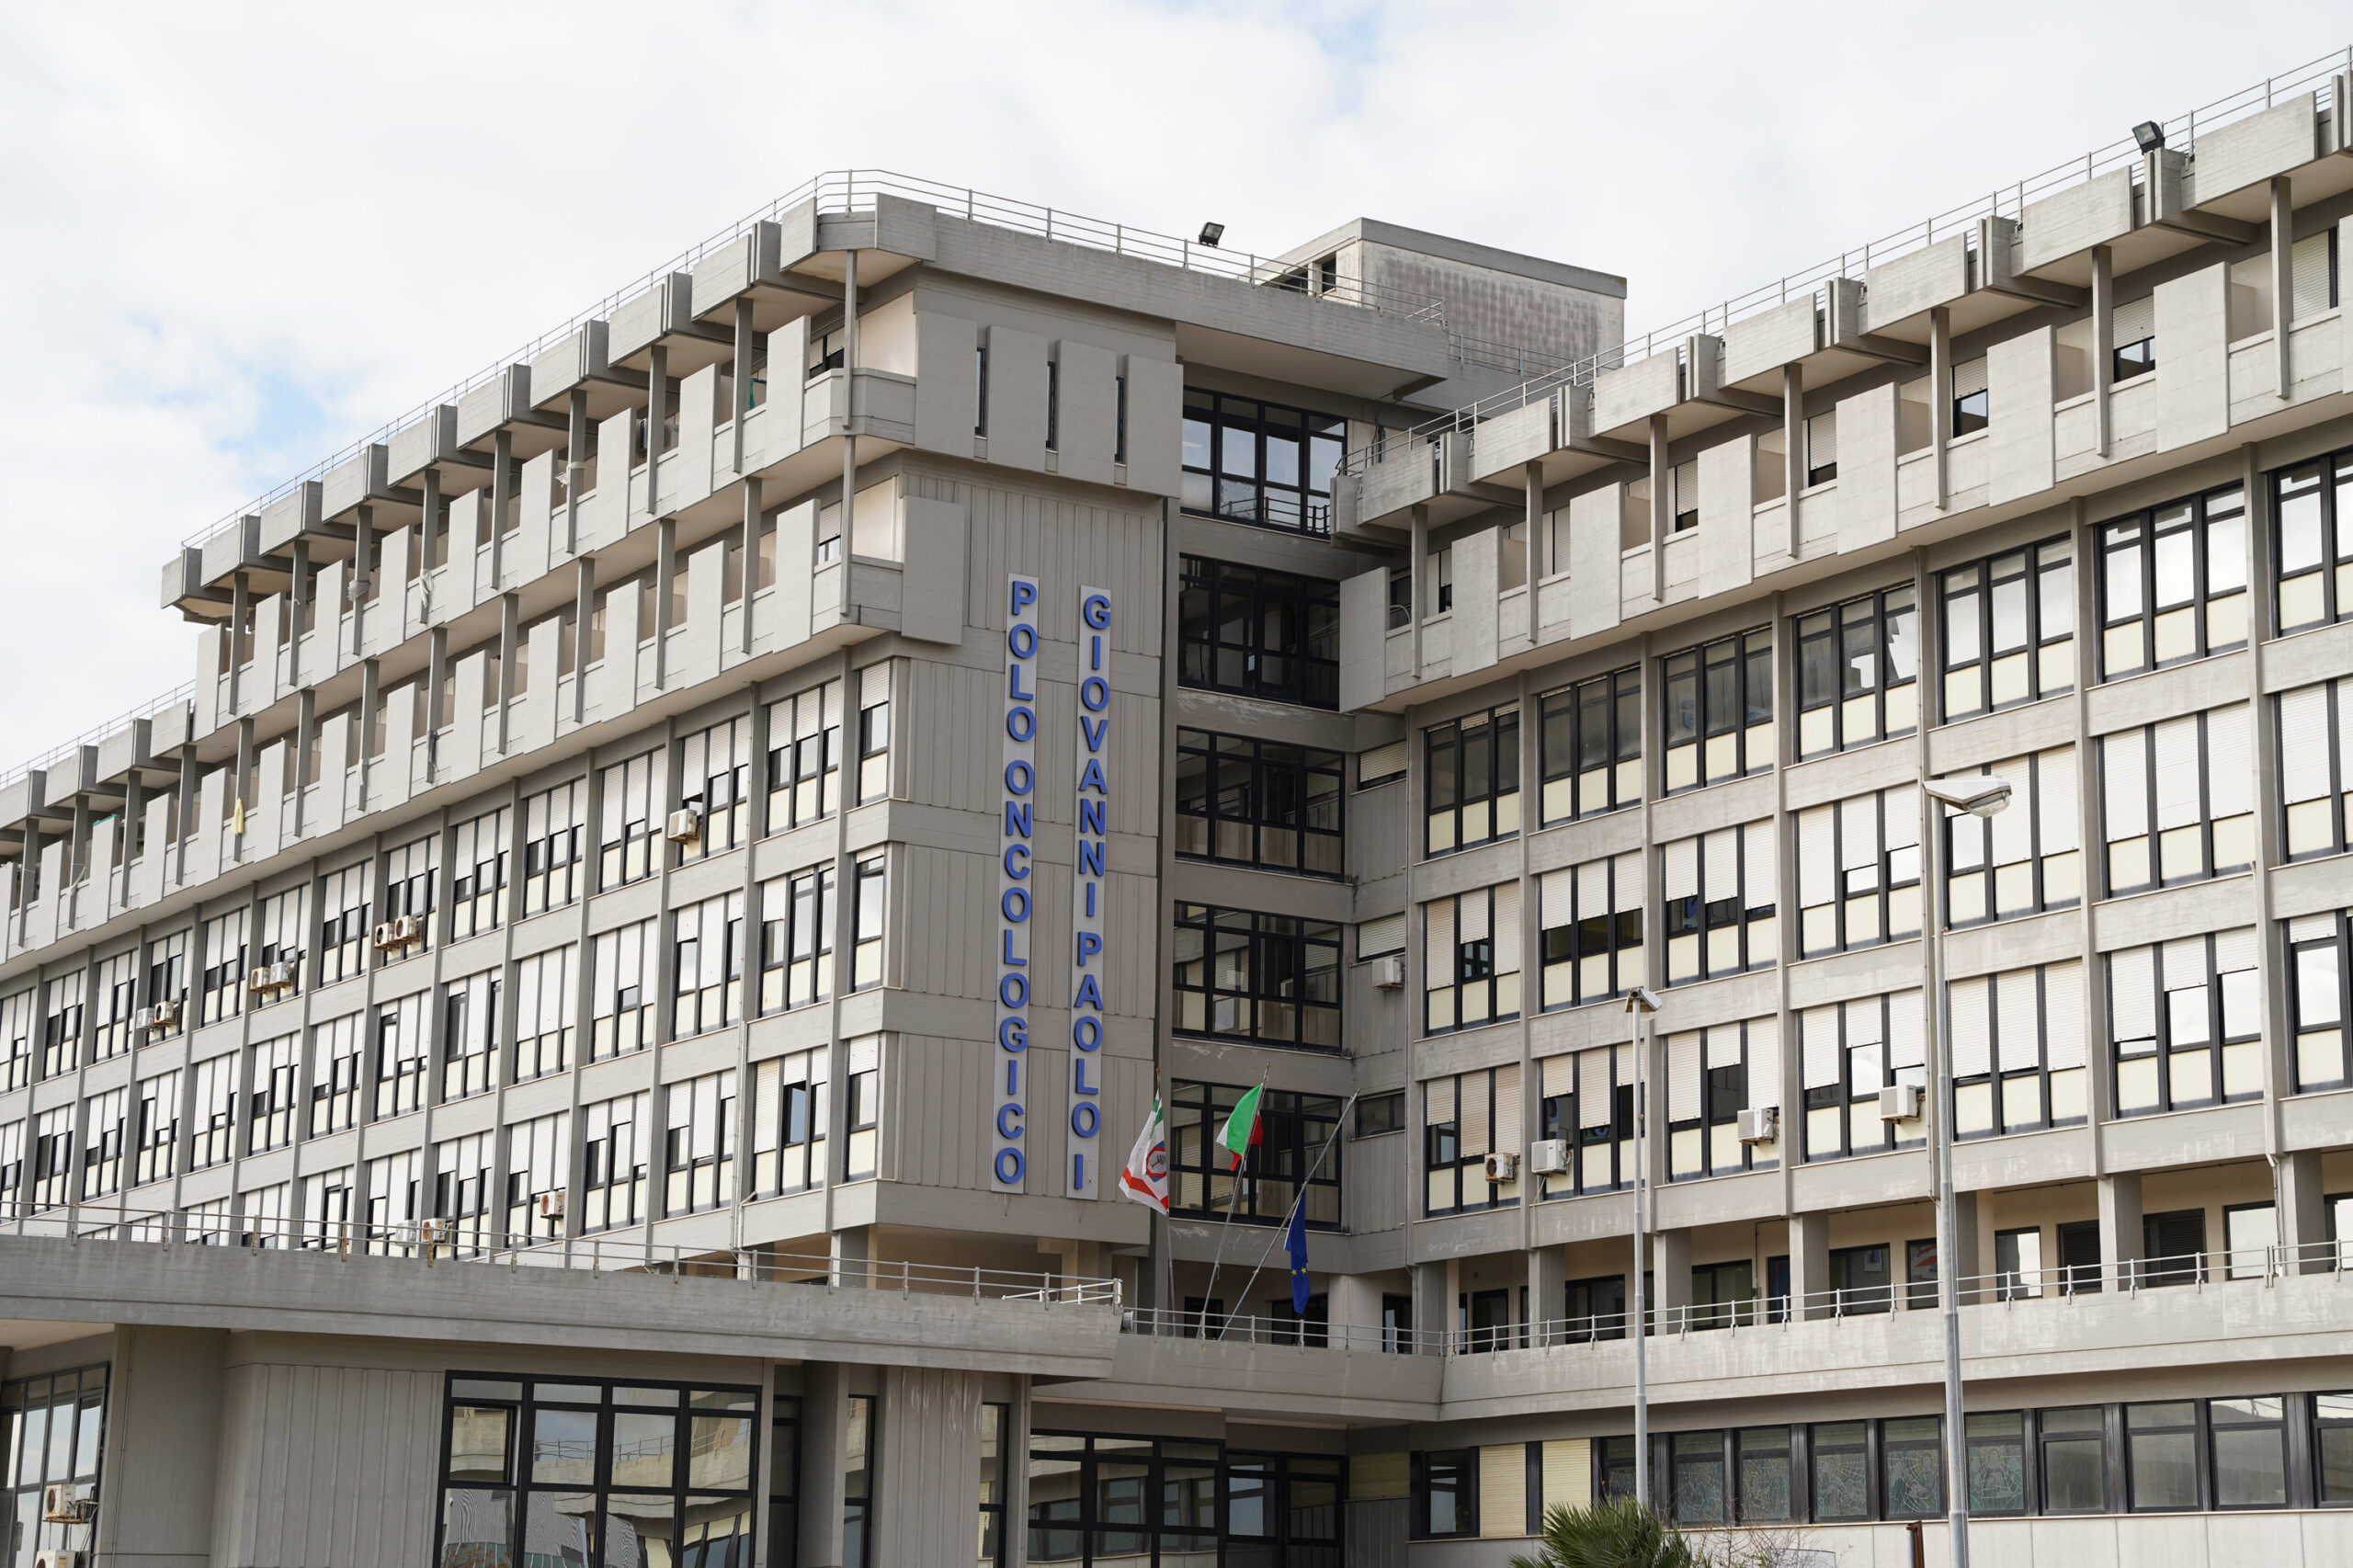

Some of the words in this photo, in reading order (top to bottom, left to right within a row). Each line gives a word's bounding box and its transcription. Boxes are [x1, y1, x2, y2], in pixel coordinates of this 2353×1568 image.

[1007, 580, 1039, 743] POLO
[1079, 594, 1111, 918] GIOVANNI
[995, 759, 1035, 1185] ONCOLOGICO
[1072, 930, 1104, 1139] PAOLO
